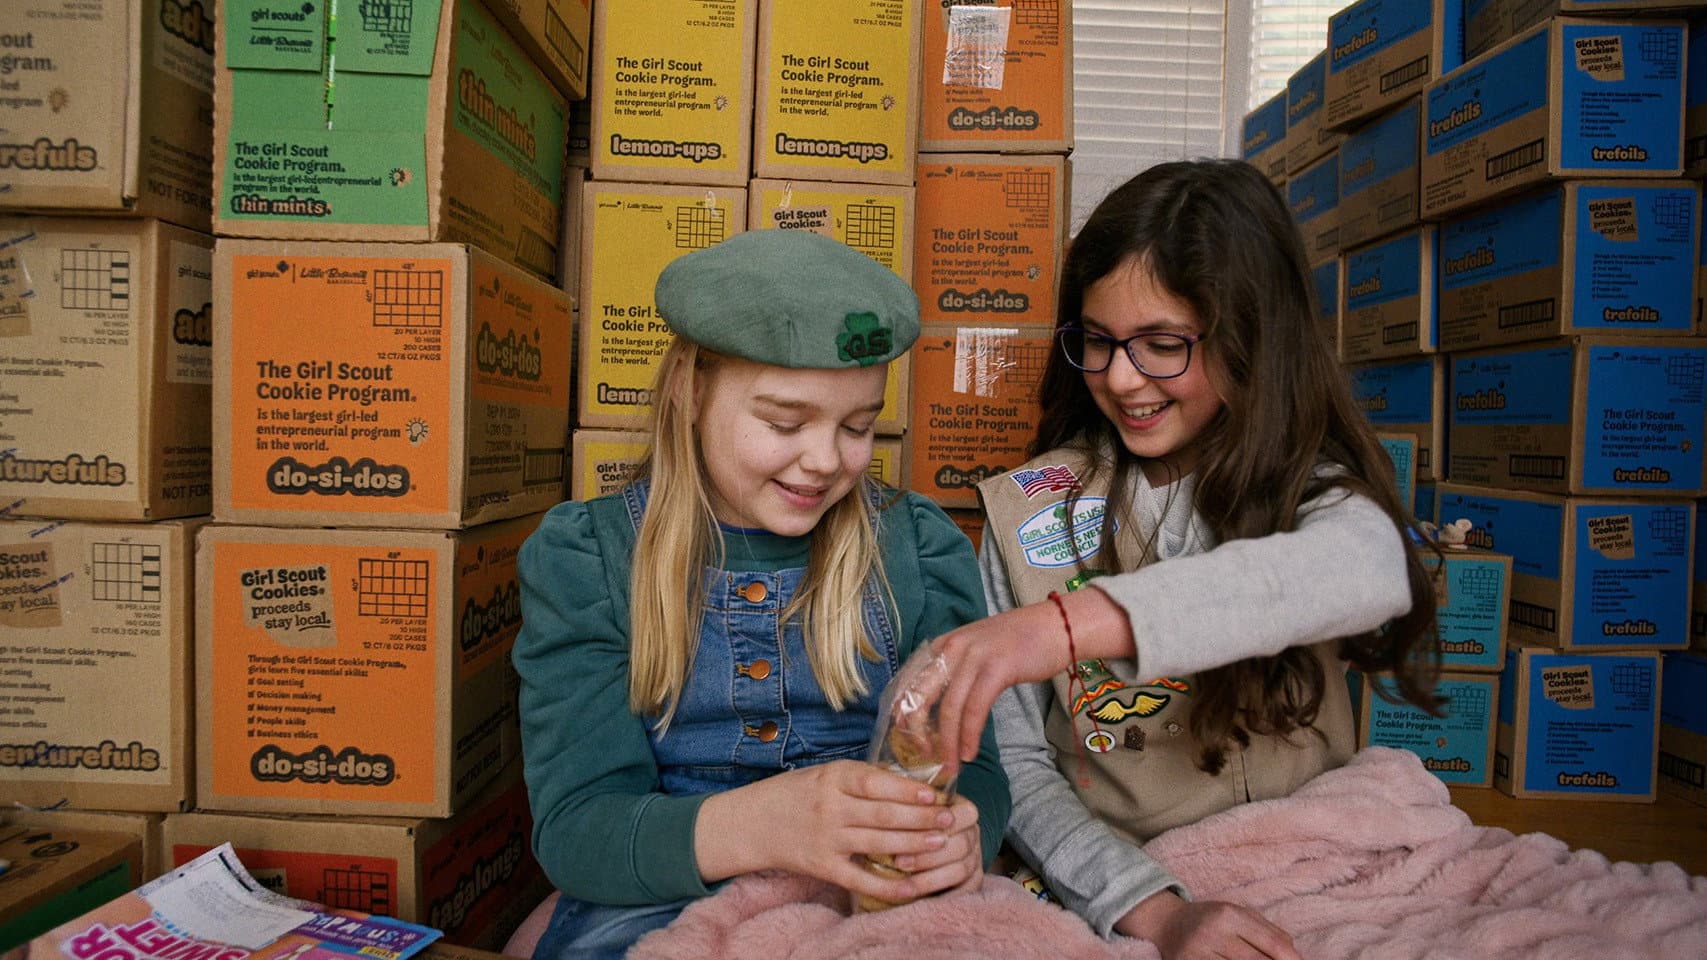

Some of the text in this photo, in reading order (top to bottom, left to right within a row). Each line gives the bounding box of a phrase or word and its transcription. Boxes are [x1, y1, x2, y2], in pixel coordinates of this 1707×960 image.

[251, 10, 305, 22] girl scouts
[616, 58, 702, 71] The Girl Scout
[782, 55, 869, 71] The Girl Scout
[616, 72, 657, 83] Cookie
[781, 70, 824, 82] Cookie
[639, 89, 666, 99] largest
[668, 90, 696, 100] girl-led
[791, 87, 803, 95] the
[805, 87, 832, 98] largest
[835, 90, 863, 99] girl-led
[615, 100, 676, 108] entrepreneurial
[780, 98, 877, 110] entrepreneurial program
[804, 108, 829, 116] world.
[950, 109, 1036, 129] do-si-dos
[236, 143, 328, 157] The Girl Scout
[612, 135, 720, 161] lemon-ups
[777, 135, 887, 162] lemon-ups
[1592, 145, 1647, 161] trefoils
[234, 157, 280, 170] Cookie
[242, 174, 256, 182] the
[257, 174, 286, 186] largest
[233, 184, 320, 194] program in the world.
[232, 195, 269, 214] thin
[774, 210, 827, 220] Girl Scout
[932, 229, 1018, 241] The Girl Scout
[932, 242, 974, 254] Cookie
[940, 291, 1027, 311] do-si-dos
[602, 306, 651, 318] The Girl
[1604, 307, 1658, 322] trefoils
[602, 320, 644, 332] Cookie
[477, 323, 541, 380] do-si-dos
[257, 361, 393, 381] The Girl Scout
[257, 382, 322, 400] Cookie
[258, 408, 378, 424] is the largest girl-led
[929, 404, 1018, 416] The Girl Scout
[929, 418, 972, 429] Cookie
[256, 425, 400, 440] entrepreneurial program
[256, 439, 329, 451] in the world.
[597, 463, 617, 473] Girl
[270, 459, 407, 494] do-si-dos
[1615, 468, 1671, 482] trefoils
[1045, 513, 1086, 533] SCOTS
[0, 551, 48, 566] Scout
[241, 566, 327, 586] Girl Scout
[252, 600, 311, 619] proceeds
[265, 612, 331, 632] stay local.
[1604, 620, 1656, 635] trefoils
[248, 655, 281, 665] Through
[282, 655, 295, 664] the
[297, 656, 312, 664] Girl
[314, 657, 335, 665] Scout
[248, 666, 266, 675] girls
[308, 667, 342, 676] essential
[1562, 671, 1588, 679] Scout
[276, 679, 304, 688] setting
[256, 691, 322, 702] Decision making
[256, 704, 335, 715] Money management
[1377, 711, 1393, 720] The
[1394, 712, 1408, 720] Girl
[256, 717, 283, 726] People
[1376, 720, 1405, 729] Cookie
[256, 730, 318, 739] Business ethics
[255, 748, 391, 782] do-si-dos
[1558, 772, 1616, 786] trefoils
